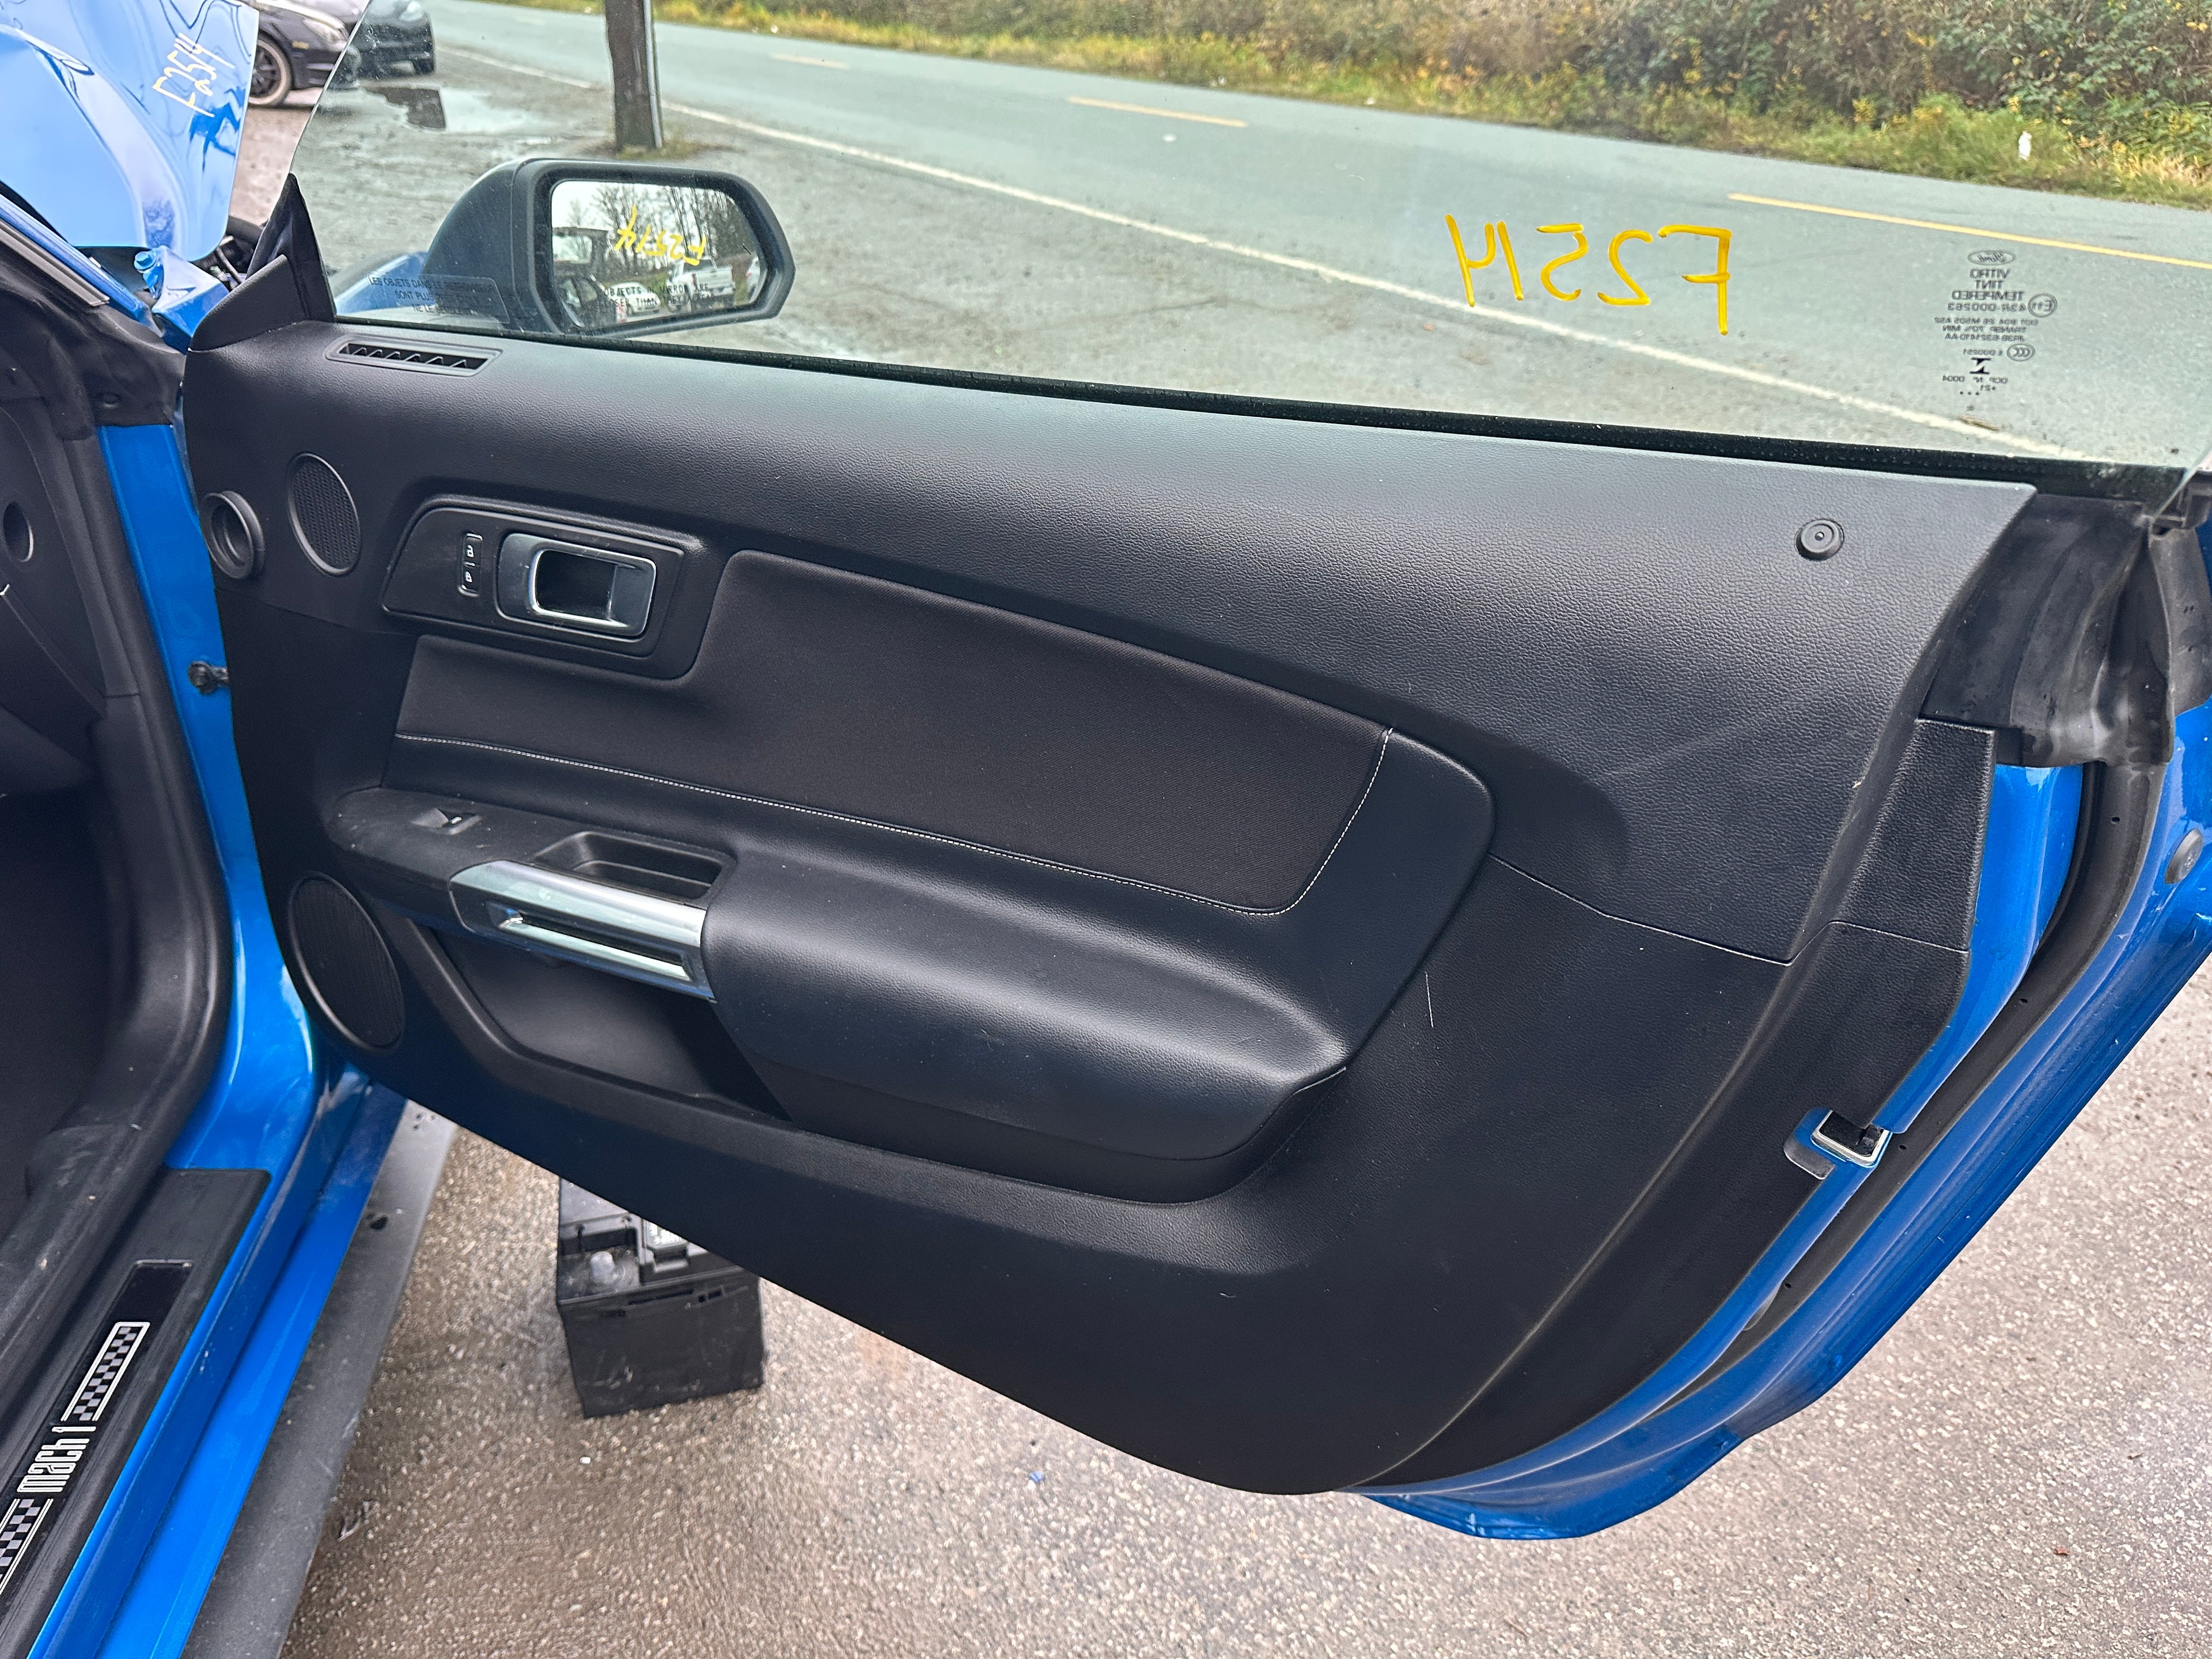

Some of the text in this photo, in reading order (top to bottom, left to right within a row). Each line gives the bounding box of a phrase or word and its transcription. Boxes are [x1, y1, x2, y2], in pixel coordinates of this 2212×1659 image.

[153, 32, 236, 118] F2514
[369, 276, 383, 286] LES
[384, 279, 411, 288] OBJETS
[411, 279, 431, 289] DANS
[395, 290, 414, 300] SONT
[415, 291, 434, 301] PLUS
[636, 297, 658, 306] THAN
[17, 1438, 90, 1493] mach
